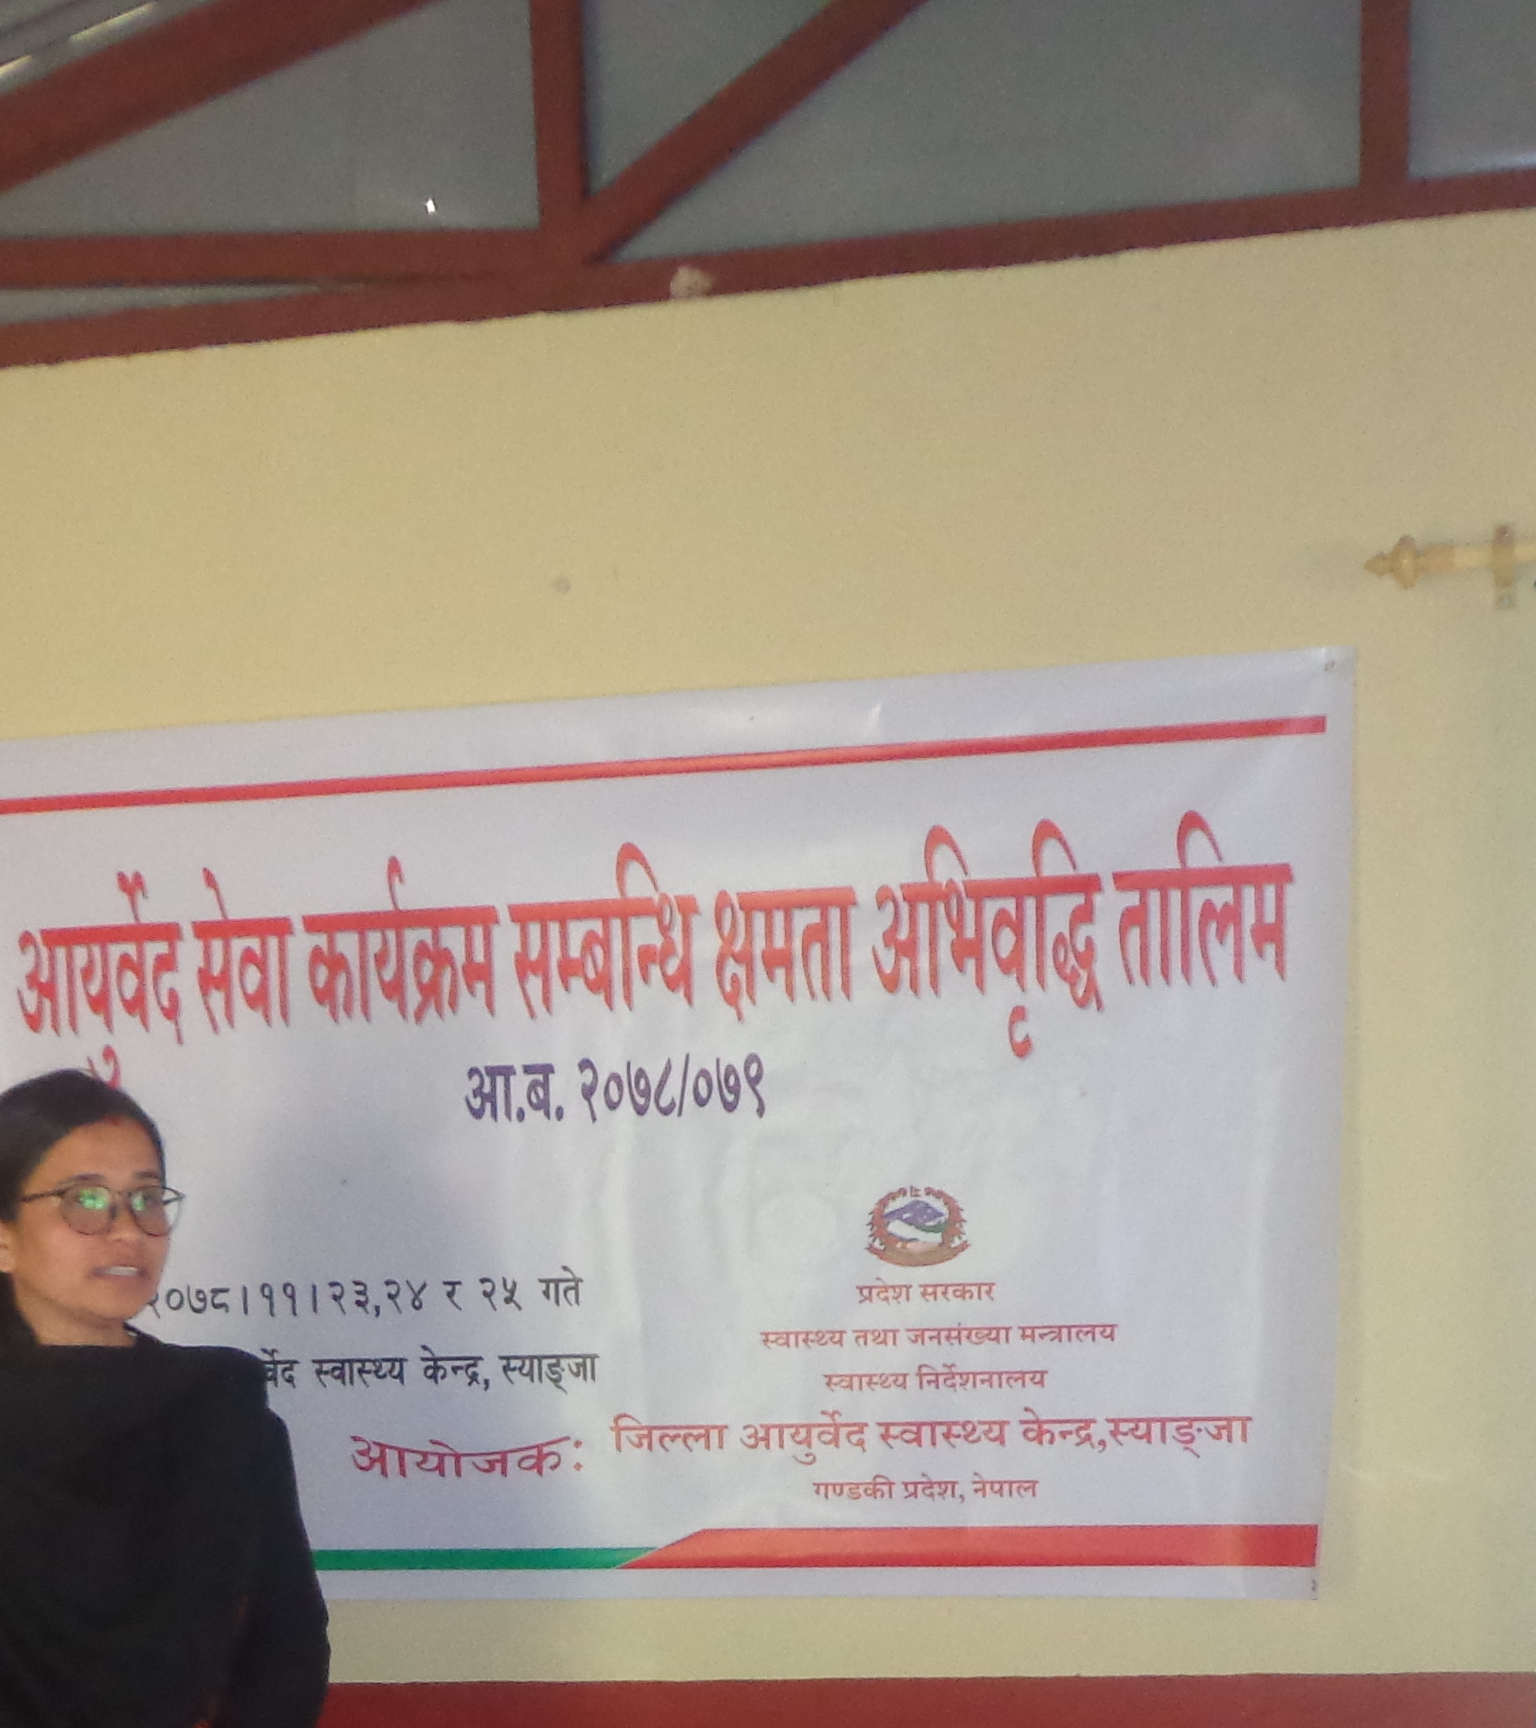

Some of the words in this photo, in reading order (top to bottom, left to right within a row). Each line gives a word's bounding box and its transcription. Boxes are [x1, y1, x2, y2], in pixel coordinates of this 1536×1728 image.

[18, 872, 182, 1088] आयुर्वेद
[192, 868, 294, 1031] सेवा
[302, 857, 499, 1024] कार्यक्रम
[508, 843, 699, 1019] सम्बन्धि
[714, 887, 858, 1021] क्षमता
[873, 819, 1103, 1058] अभिवृद्धि
[1112, 810, 1294, 986] तालिम
[465, 1064, 563, 1122] आ.ब.
[578, 1054, 765, 1123] २०७८/०७९
[443, 1281, 462, 1310] र
[479, 1277, 521, 1311] २५
[538, 1266, 583, 1306] गते
[856, 1277, 912, 1303] प्रदेश
[919, 1282, 995, 1301] सरकार
[760, 1330, 847, 1348] स्वास्थ्य
[852, 1329, 899, 1346] तथा
[906, 1323, 1012, 1345] जनसंख्या
[1018, 1324, 1117, 1343] मन्त्रालय
[312, 1358, 408, 1387] स्वास्थ्य
[420, 1345, 489, 1391] केन्द्र,
[497, 1354, 598, 1390] स्याङ्जा
[823, 1373, 909, 1391] स्वास्थ्य
[915, 1364, 1048, 1390] निर्देशनालय
[610, 1413, 728, 1452] जिल्ला
[741, 1410, 869, 1465] आयुर्वेद
[877, 1420, 1010, 1448] स्वास्थ्य
[813, 1474, 896, 1500] गण्डकी
[902, 1473, 964, 1502] प्रदेश,
[972, 1472, 1039, 1498] नेपाल
